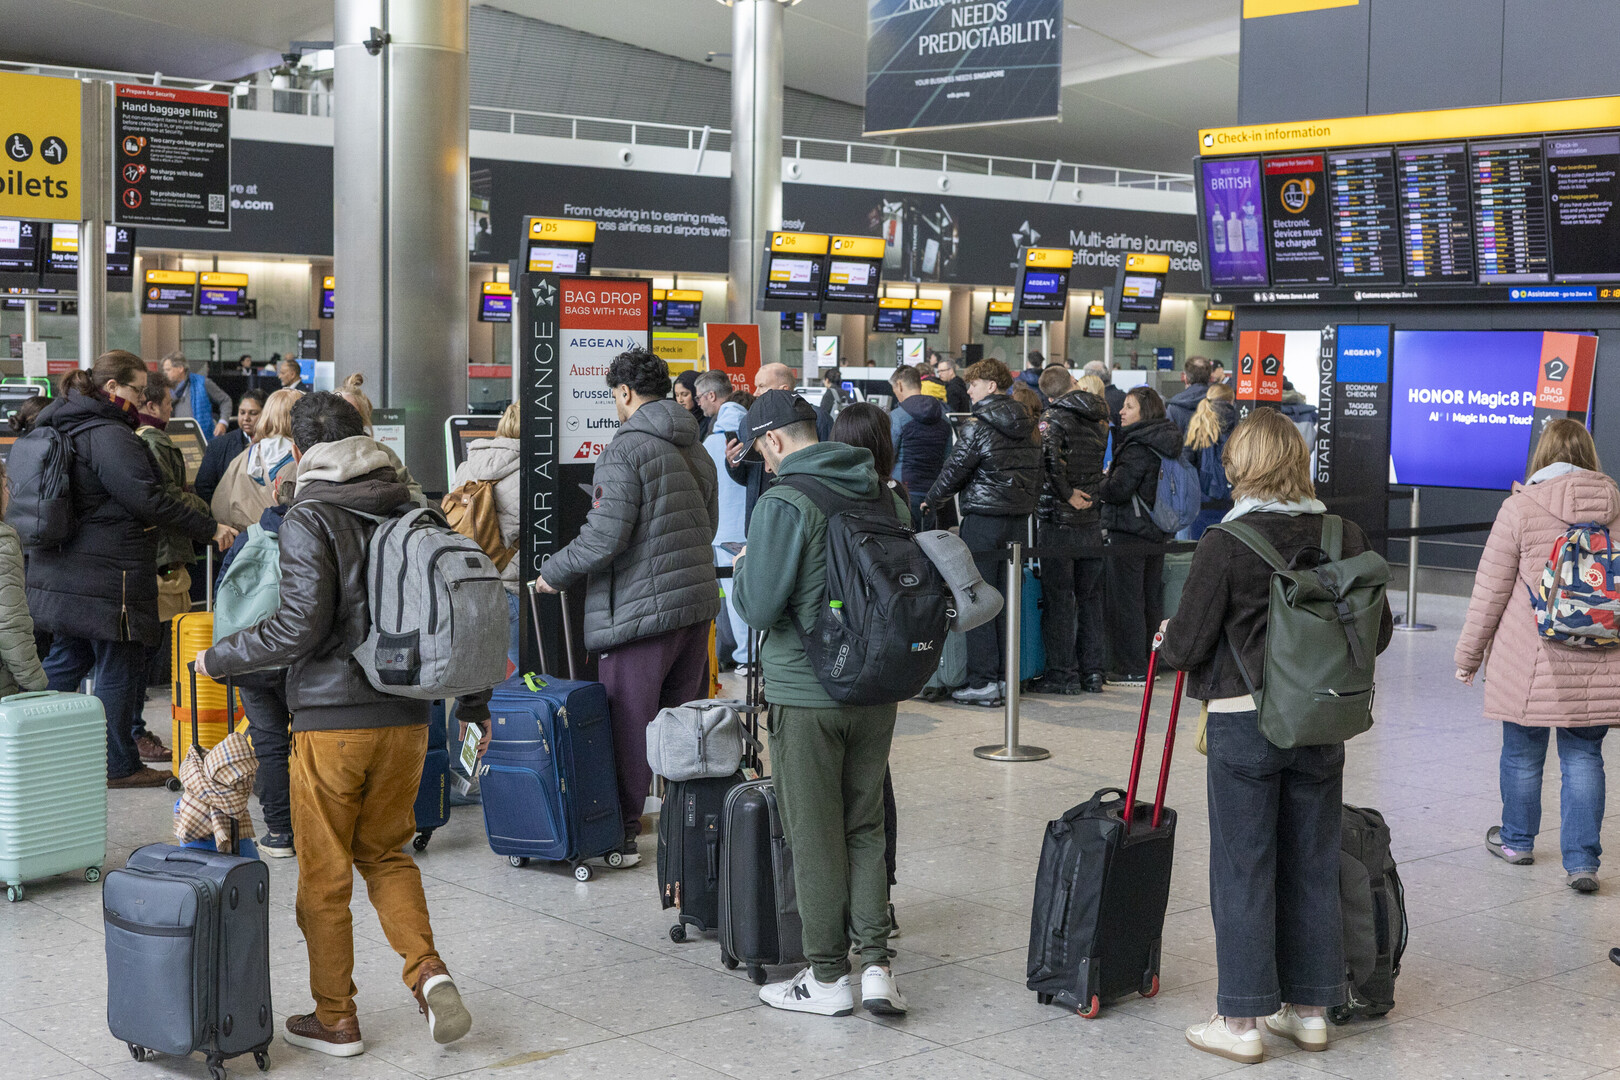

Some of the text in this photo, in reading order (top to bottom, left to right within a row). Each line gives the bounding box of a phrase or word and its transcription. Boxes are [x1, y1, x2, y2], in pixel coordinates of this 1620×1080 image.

[951, 2, 1008, 28] NEEDS
[918, 18, 1056, 56] PREDICTABILITY.
[914, 70, 1005, 86] YOUR BUSINESS NEEDS SINGAPORE
[126, 88, 146, 96] Prepare
[156, 90, 176, 99] Security
[122, 101, 218, 119] Hand baggage limits
[1217, 126, 1331, 144] Check-in information
[246, 184, 258, 194] at
[1211, 177, 1251, 190] BRITISH
[231, 199, 274, 210] e.com
[564, 204, 728, 226] From checking in to earning miles,
[546, 223, 558, 232] D5
[618, 221, 651, 232] airlines
[653, 223, 672, 234] and
[674, 224, 710, 237] airports
[712, 228, 731, 237] with
[1273, 218, 1310, 228] Electronic
[1274, 228, 1322, 238] devices must
[785, 237, 796, 245] D6
[1070, 230, 1198, 256] Multi-airline journeys
[1275, 238, 1316, 249] be charged
[52, 253, 78, 261] Bag drop
[565, 291, 641, 305] BAG DROP
[565, 307, 641, 316] BAGS WITH TAGS
[570, 339, 623, 348] AEGEAN
[728, 340, 737, 363] 1
[1243, 357, 1252, 373] 2
[1266, 358, 1276, 374] 2
[1548, 361, 1563, 379] 2
[727, 373, 745, 382] TAG
[1544, 386, 1563, 395] BAG
[1408, 389, 1464, 405] HONOR
[1468, 390, 1519, 409] Magic8
[1539, 394, 1565, 403] DROP
[1318, 347, 1334, 483] STAR ALLIANCE
[1429, 412, 1439, 421] AI
[1453, 413, 1478, 425] Magic
[1479, 414, 1488, 423] In
[1488, 414, 1507, 424] One
[534, 322, 554, 572] STAR ALLIANCE
[831, 644, 850, 678] OGIO
[24, 700, 92, 716] DELSEY PARIS
[794, 984, 811, 1000] N
